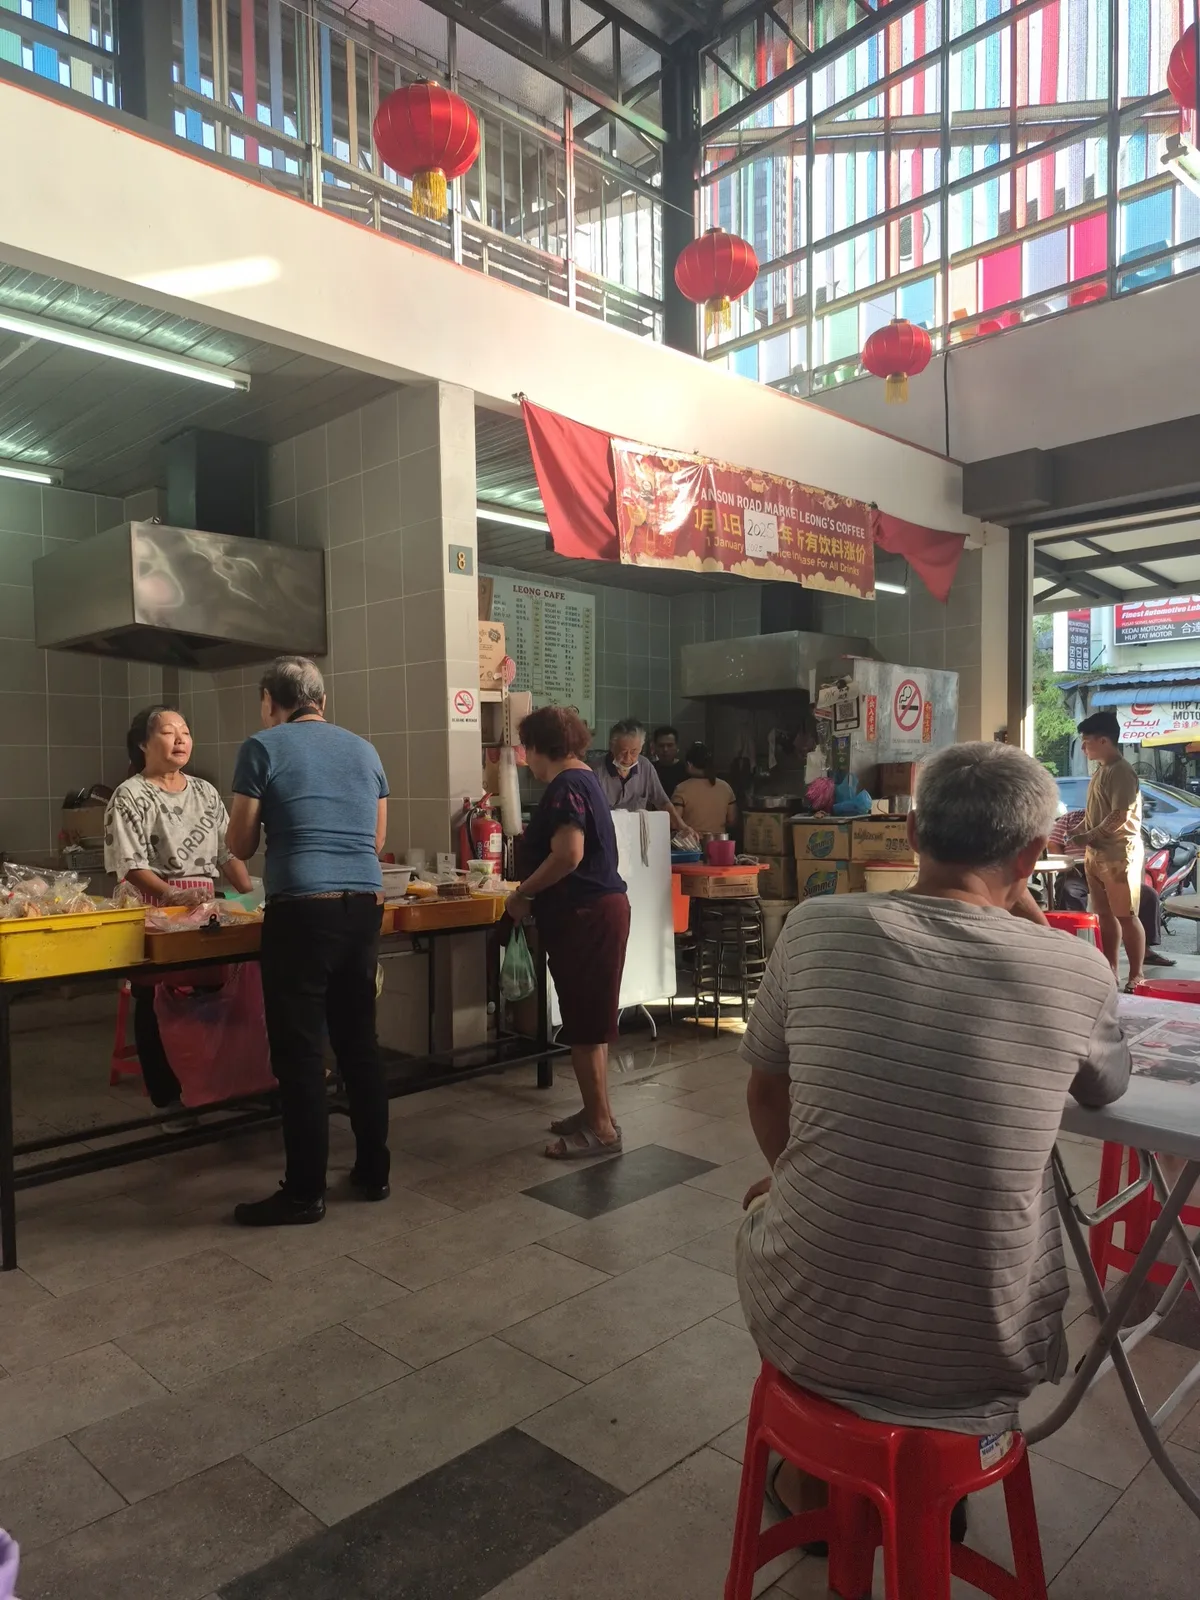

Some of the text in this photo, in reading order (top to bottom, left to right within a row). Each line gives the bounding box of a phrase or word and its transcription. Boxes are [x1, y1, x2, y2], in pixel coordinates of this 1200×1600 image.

[701, 487, 865, 539] ANSON ROAD MARKE LEONG'S COFFEE
[747, 518, 775, 539] 2025
[714, 536, 744, 554] January
[457, 551, 465, 570] 8
[816, 557, 828, 568] For
[829, 561, 838, 571] All
[840, 563, 860, 576] Drinks
[513, 584, 566, 600] LEONG CAFE
[1122, 610, 1144, 619] Finest
[1144, 606, 1187, 617] Automotive
[1140, 624, 1176, 633] MOTOSIKAL
[1171, 701, 1191, 710] HUP
[803, 879, 836, 898] Summer
